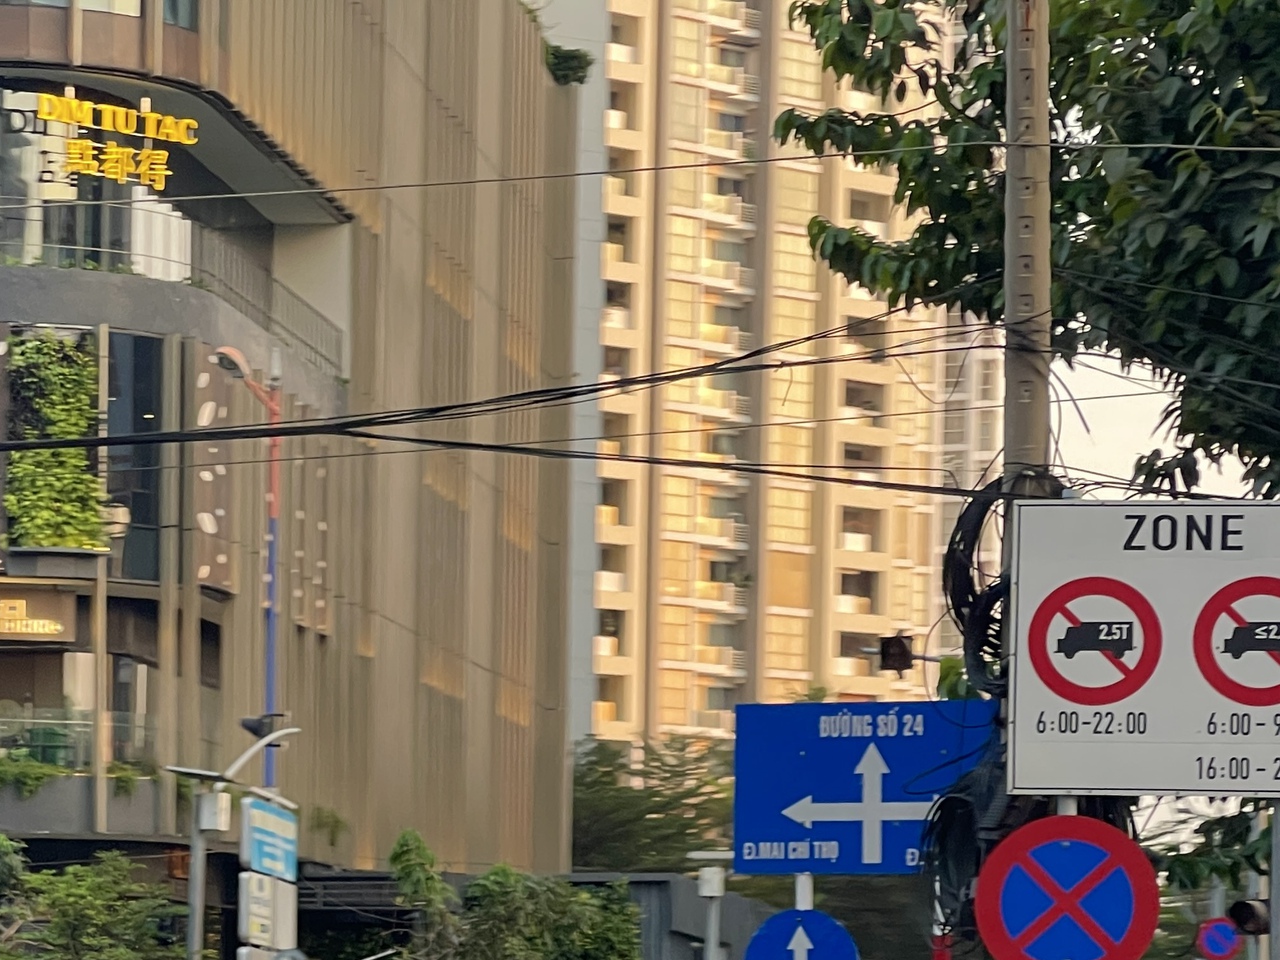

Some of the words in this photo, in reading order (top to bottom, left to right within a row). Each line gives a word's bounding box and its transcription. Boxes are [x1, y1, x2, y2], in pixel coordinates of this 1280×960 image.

[96, 103, 137, 134] TU
[142, 111, 199, 145] TAC
[1123, 514, 1245, 551] ZONE
[877, 706, 899, 737] SỐ
[902, 714, 925, 736] 24
[1036, 711, 1148, 735] 6:00-22:00
